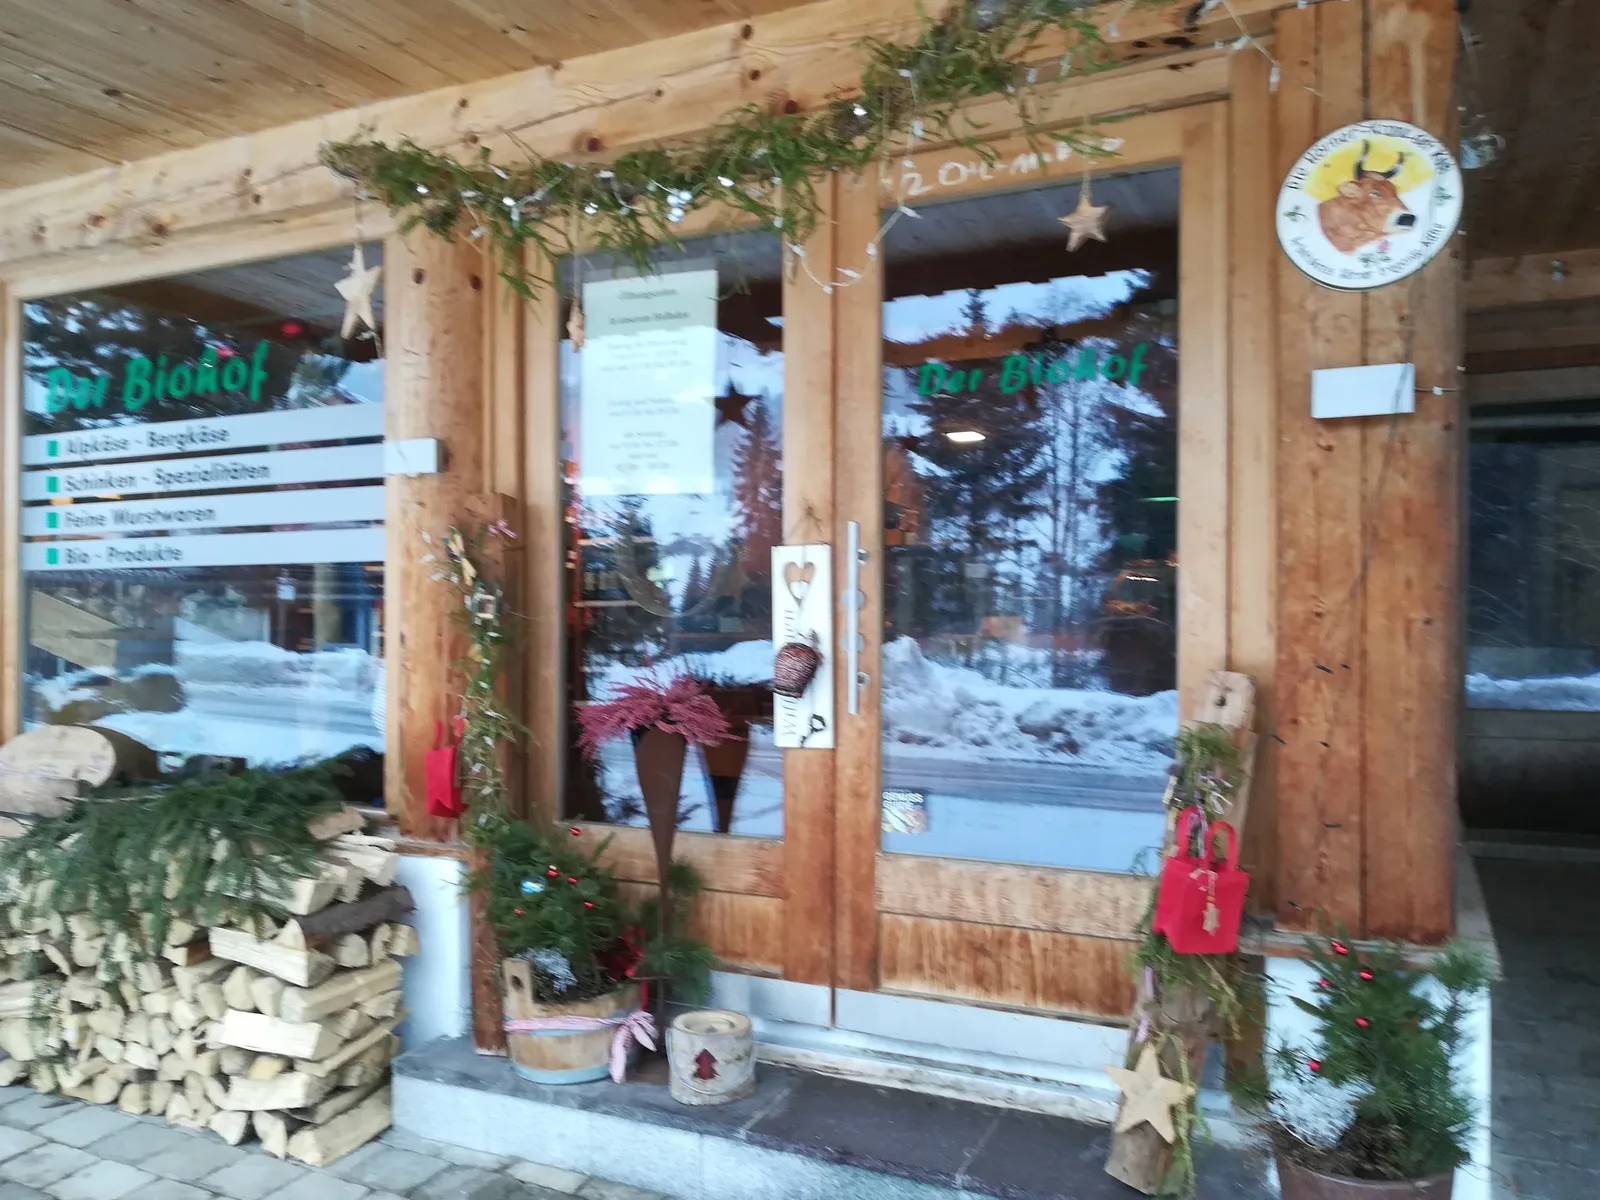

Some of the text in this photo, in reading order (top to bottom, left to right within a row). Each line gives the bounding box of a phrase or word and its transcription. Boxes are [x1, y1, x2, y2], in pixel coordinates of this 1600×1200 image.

[46, 339, 270, 413] Der Biohof
[918, 343, 1148, 396] Der Biohof
[66, 434, 130, 456] Alpkäse
[147, 425, 230, 452] Bergkäse
[64, 470, 137, 492] Schinken
[154, 462, 270, 490] Spezialitäten
[64, 508, 217, 528] Feine Wurstwaren
[65, 547, 92, 564] Bio
[106, 542, 184, 563] Produkte
